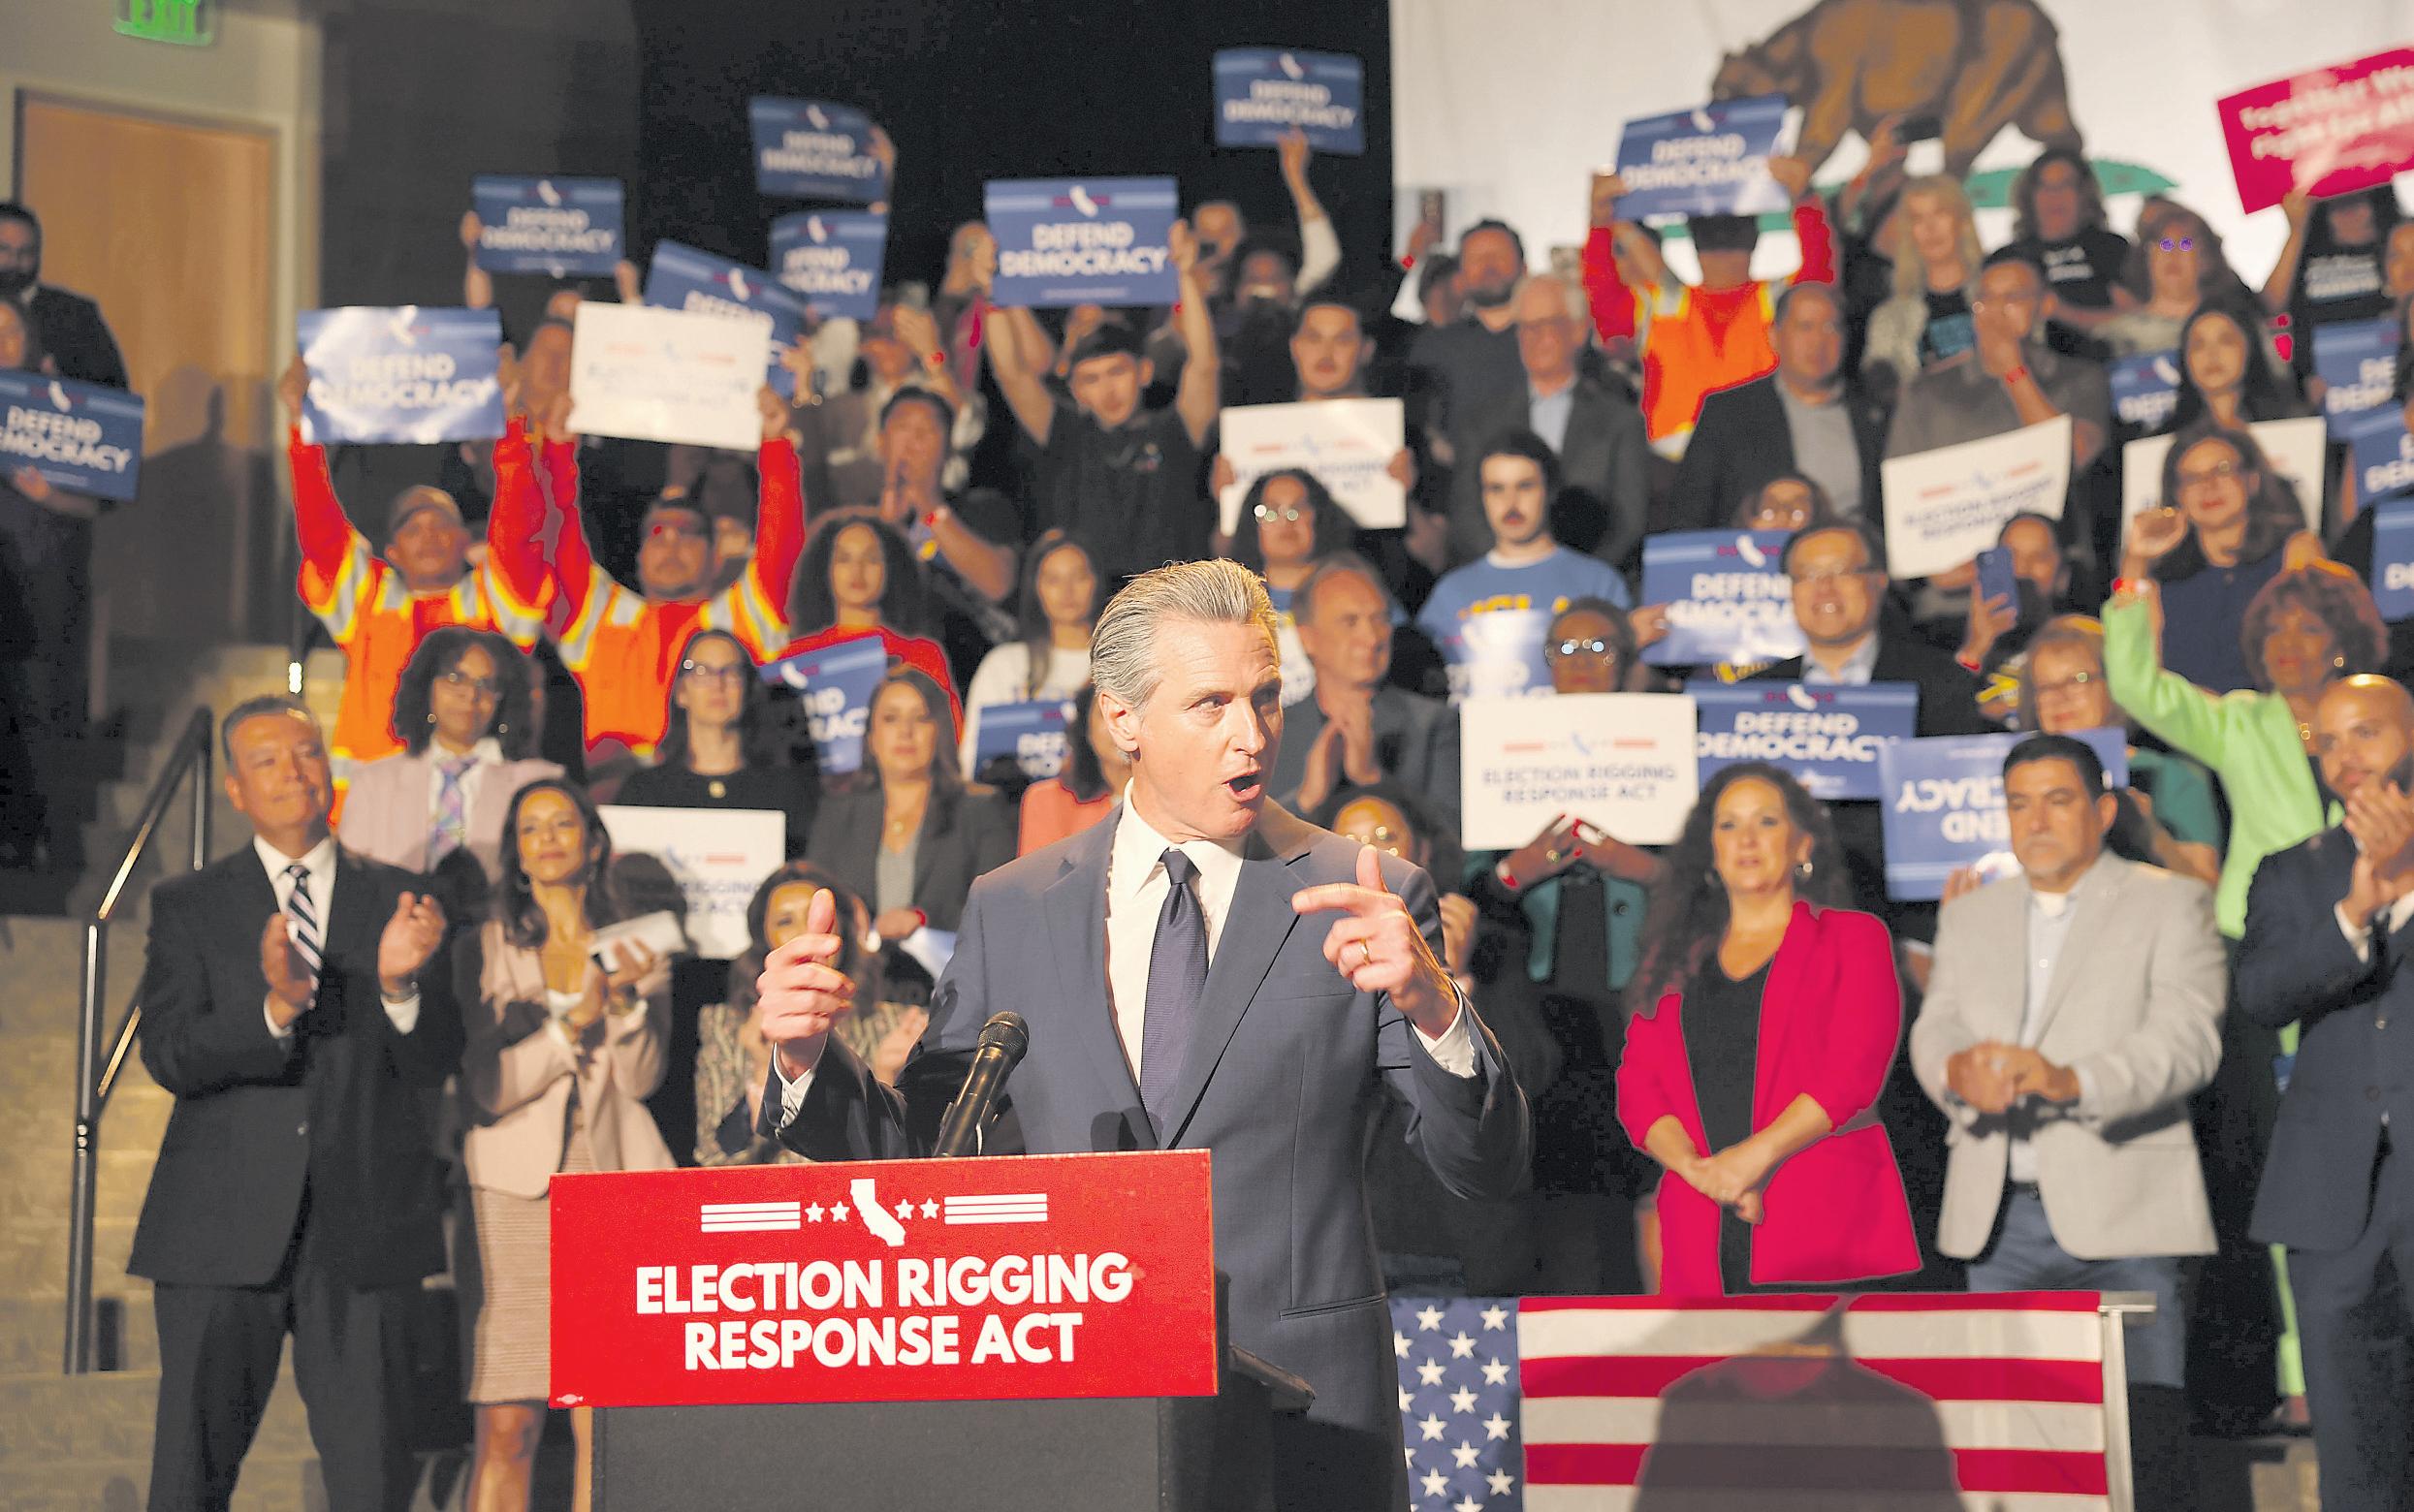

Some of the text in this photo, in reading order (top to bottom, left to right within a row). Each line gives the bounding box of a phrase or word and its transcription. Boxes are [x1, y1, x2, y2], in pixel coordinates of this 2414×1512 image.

[1620, 157, 1774, 192] DEMOCRAC
[1032, 221, 1135, 250] DEFEND
[999, 246, 1169, 277] DEMOCRACY
[778, 269, 873, 295] MOCRACY
[7, 405, 103, 444] DEFEND
[0, 428, 132, 473] MOCRACY
[1691, 572, 1793, 600] DEFEN
[1664, 599, 1797, 630] EMOCRA
[1733, 710, 1859, 738] DEFEND
[1483, 763, 1677, 786] ELECTION RIGGING
[1504, 784, 1657, 805] RESPONSE ACT
[1895, 775, 2008, 812] CRACY
[636, 1251, 1134, 1314] ELECTION RIGGING
[684, 1311, 1083, 1370] RESPONSE ACT
